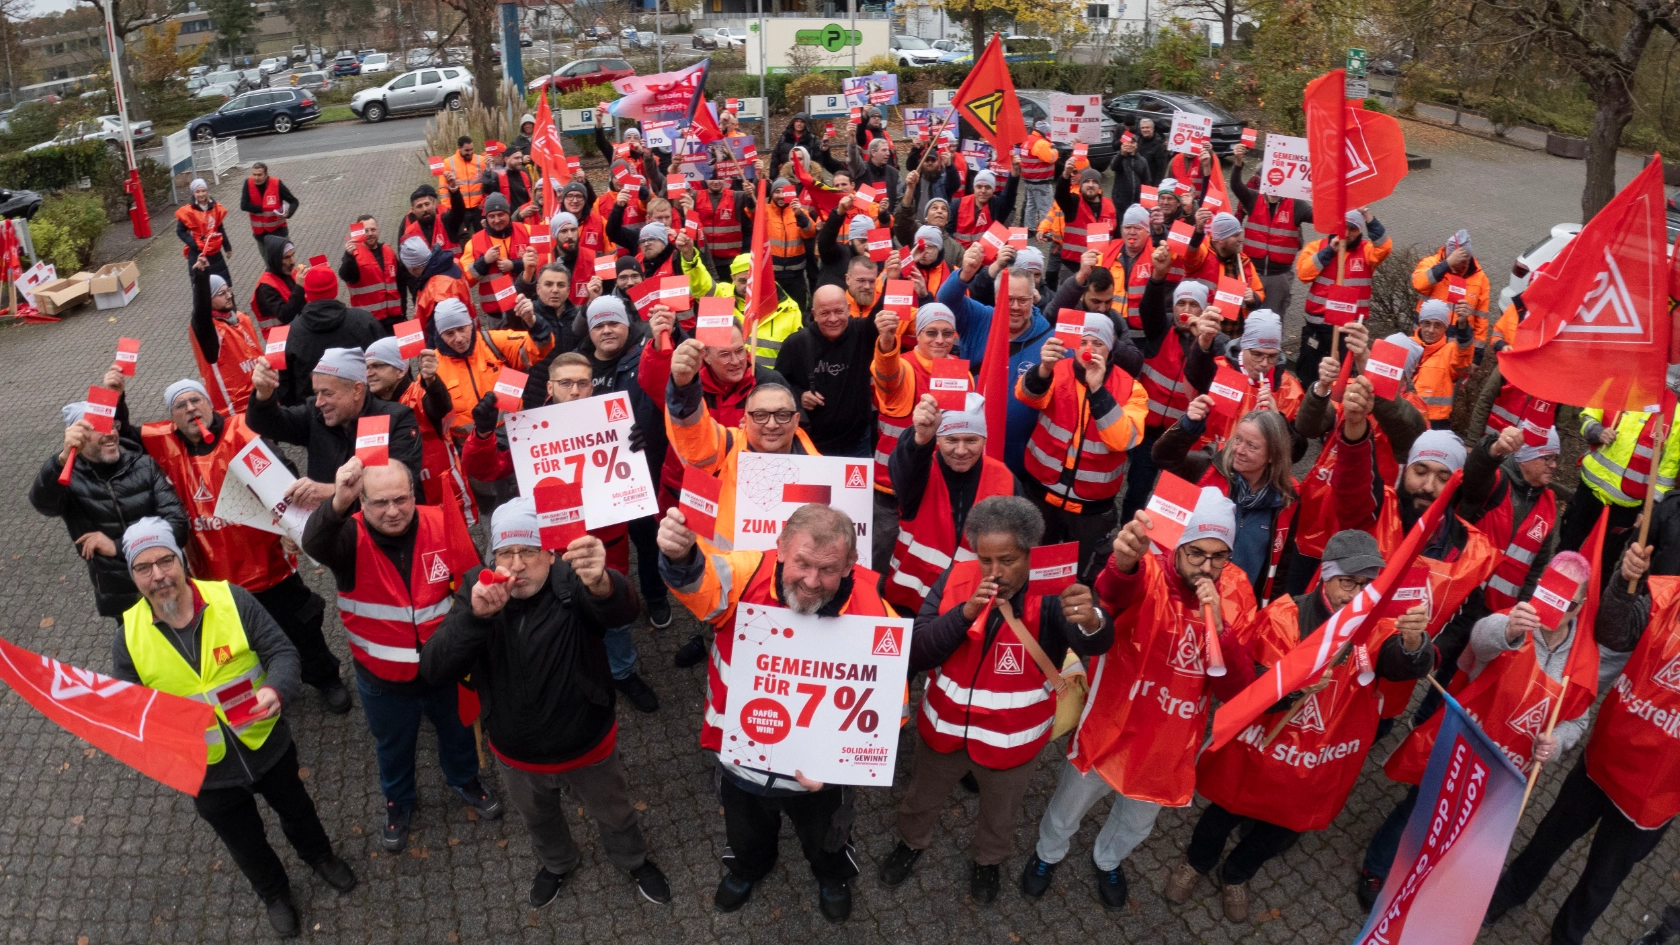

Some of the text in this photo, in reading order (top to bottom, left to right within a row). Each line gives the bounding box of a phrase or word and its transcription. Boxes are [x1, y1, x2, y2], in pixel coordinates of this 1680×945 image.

[1273, 152, 1310, 162] GEMEINSA
[530, 429, 619, 459] GEMEINSAM
[533, 456, 561, 475] FÜR
[612, 486, 647, 499] SOLIDARITÄT
[742, 519, 777, 534] ZUM
[756, 653, 878, 683] GEMEINSAM
[753, 674, 790, 696] FÜR
[752, 708, 779, 719] DAFÜR
[747, 717, 784, 728] STREITEN
[756, 726, 775, 735] WIR!
[841, 746, 889, 755] SOLIDARITÄT
[1271, 739, 1361, 769] streiken
[1428, 744, 1466, 848] uns das
